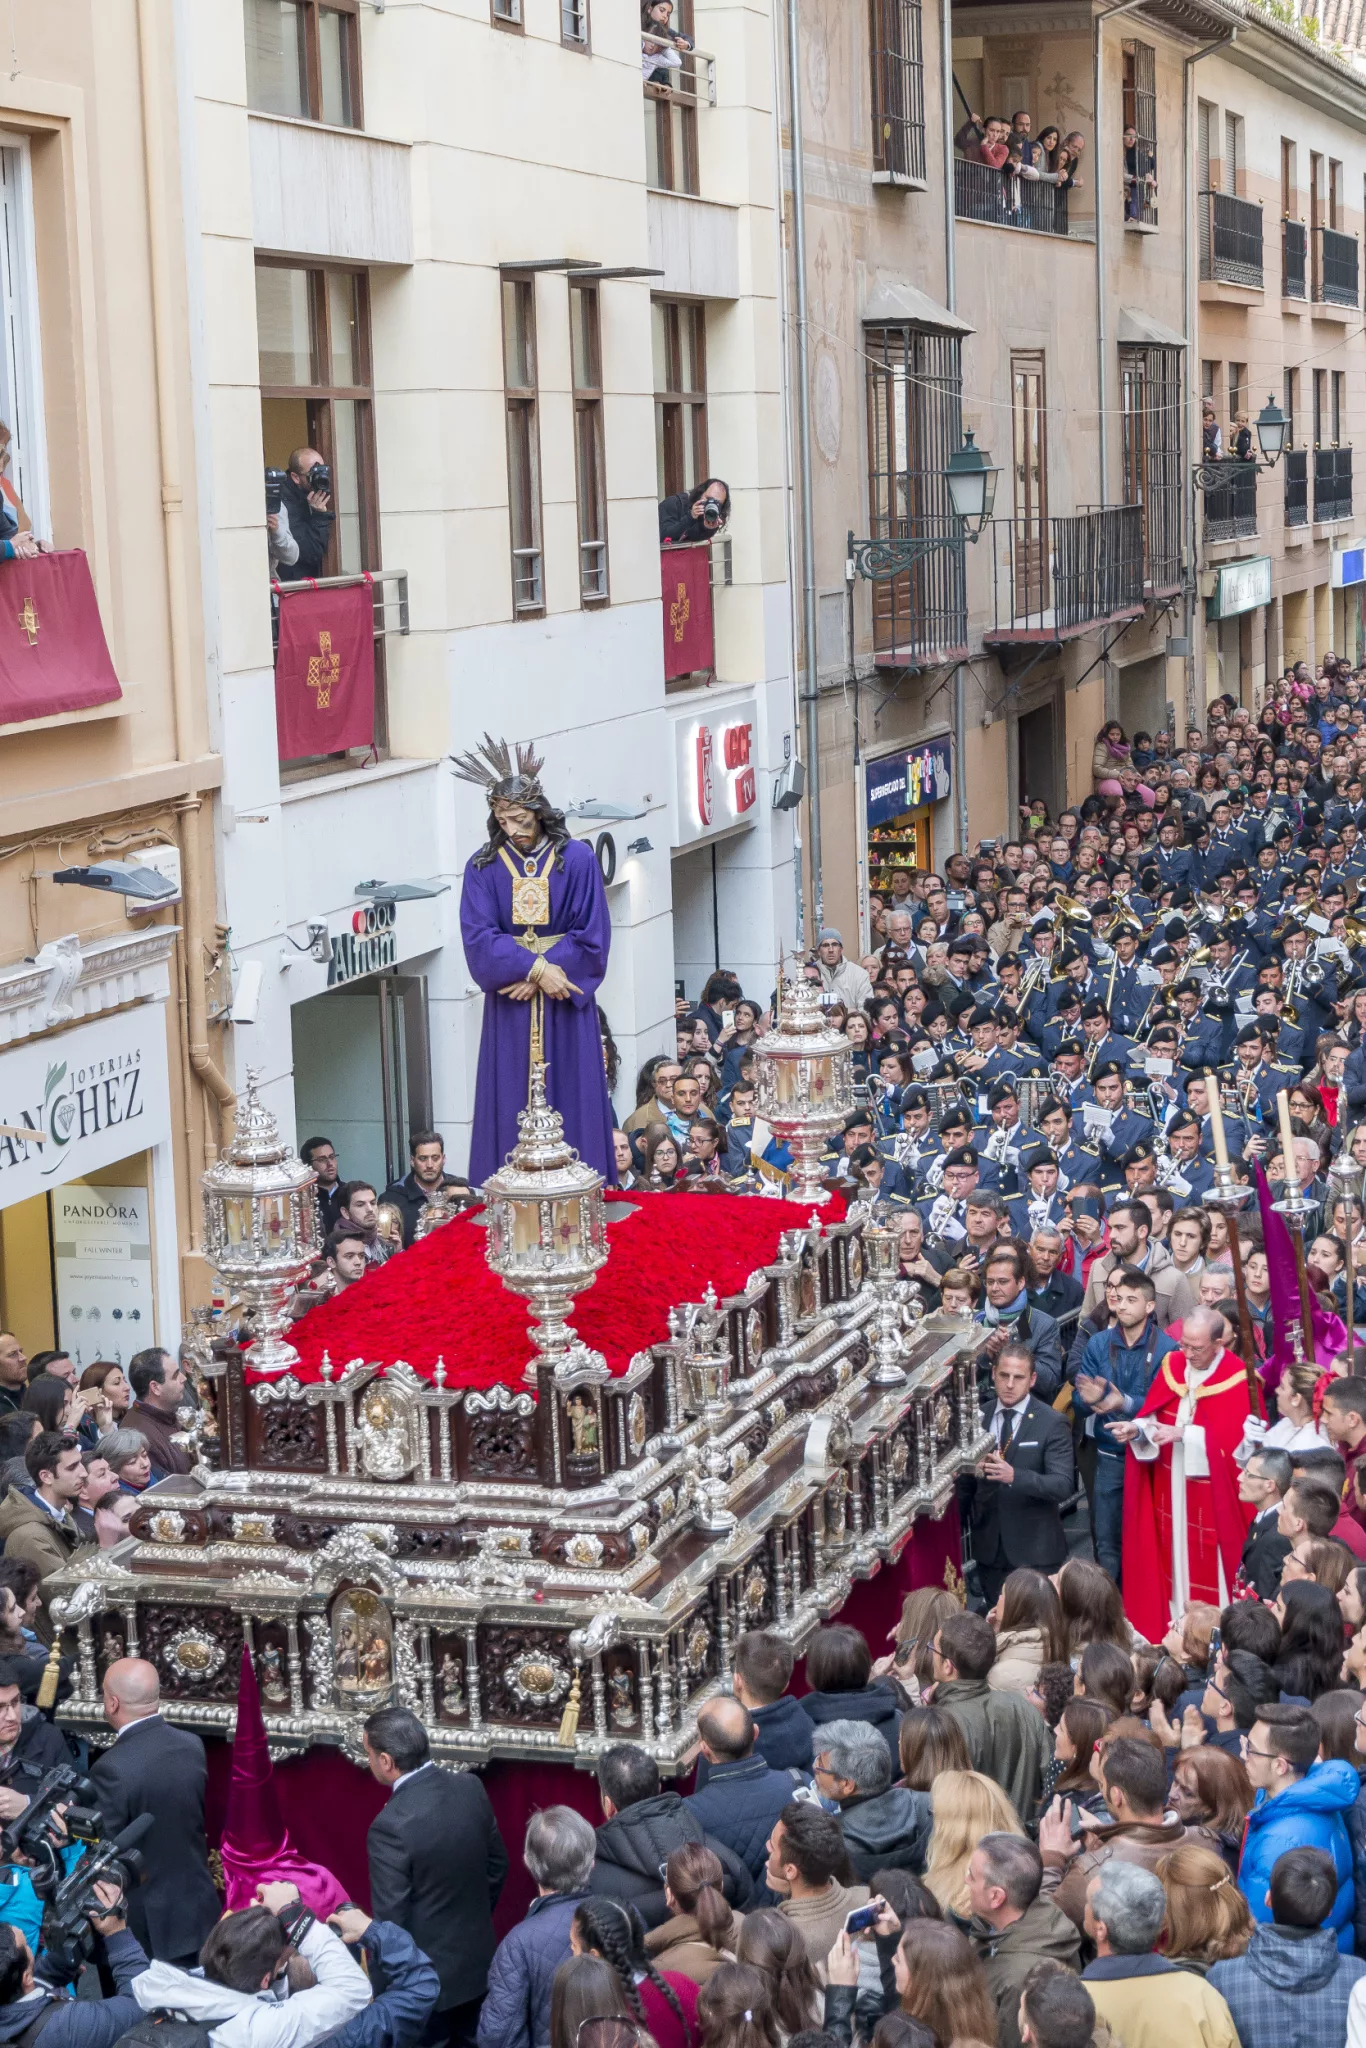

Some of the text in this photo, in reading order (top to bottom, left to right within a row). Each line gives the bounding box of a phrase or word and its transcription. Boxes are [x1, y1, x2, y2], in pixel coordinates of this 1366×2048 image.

[742, 777, 754, 805] tv
[69, 1048, 142, 1095] JOYERIAS
[63, 1202, 139, 1219] PANDORA
[84, 1246, 98, 1254] FALL
[293, 1916, 312, 1942] DIGITAL
